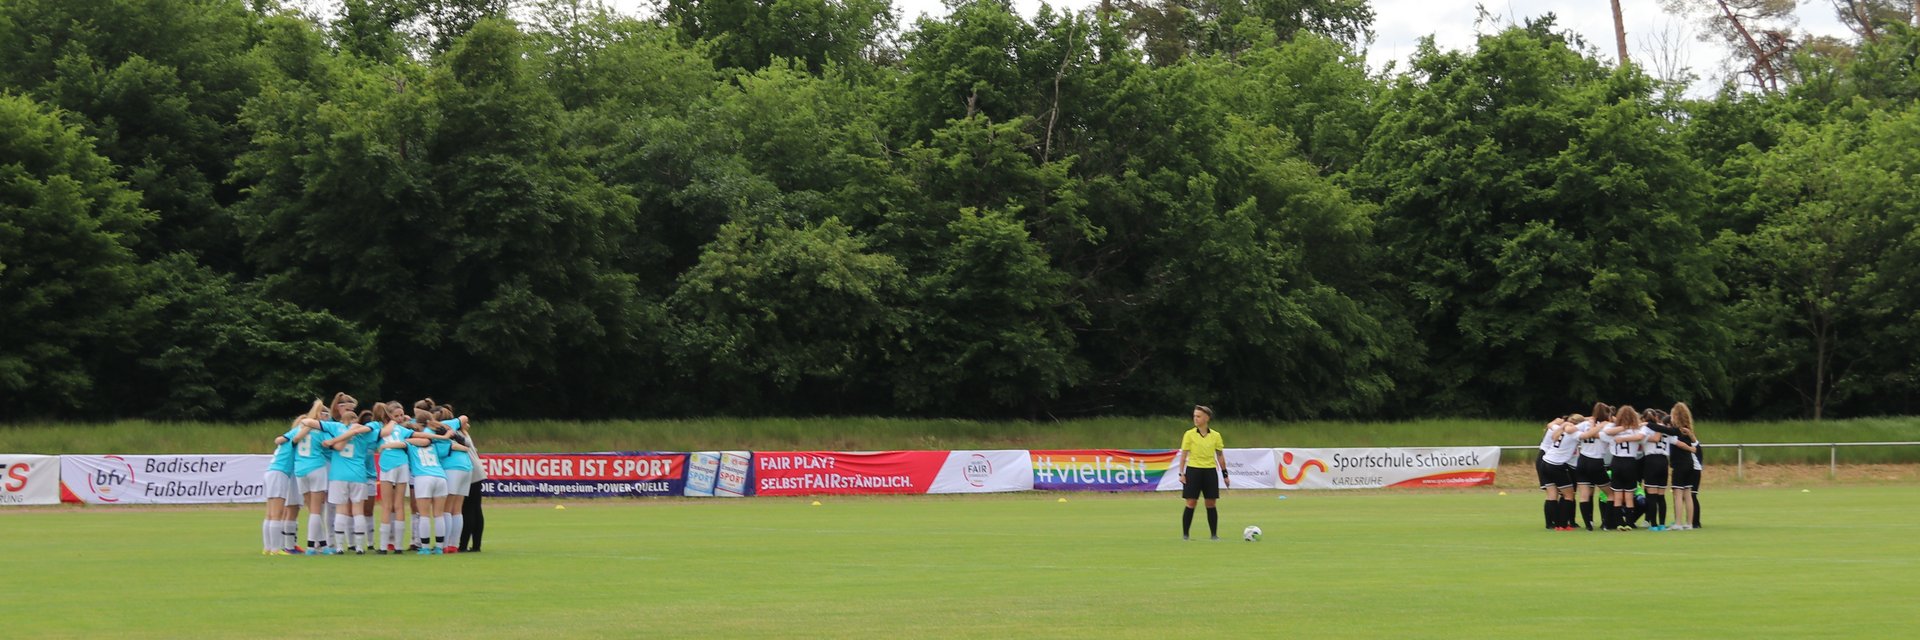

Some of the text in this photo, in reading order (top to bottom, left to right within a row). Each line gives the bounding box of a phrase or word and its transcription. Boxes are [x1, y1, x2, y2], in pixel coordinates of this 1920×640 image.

[145, 458, 226, 473] Badischer
[579, 459, 607, 477] IST
[613, 458, 672, 477] SPORT
[760, 456, 836, 470] FAIR PLAY?
[968, 465, 987, 473] FAIR
[1332, 452, 1480, 471] Sportschule Schöneck
[719, 471, 745, 484] SPORT
[1037, 456, 1149, 484] #vielfalt
[96, 469, 127, 487] bfv
[760, 473, 913, 490] SELBSTFAIRSTÄNDLICH.
[1332, 476, 1383, 486] KARLSRUHE
[145, 481, 264, 497] Fußballverban
[497, 481, 670, 495] Calcium-Magnesium-POWER-QUELLE
